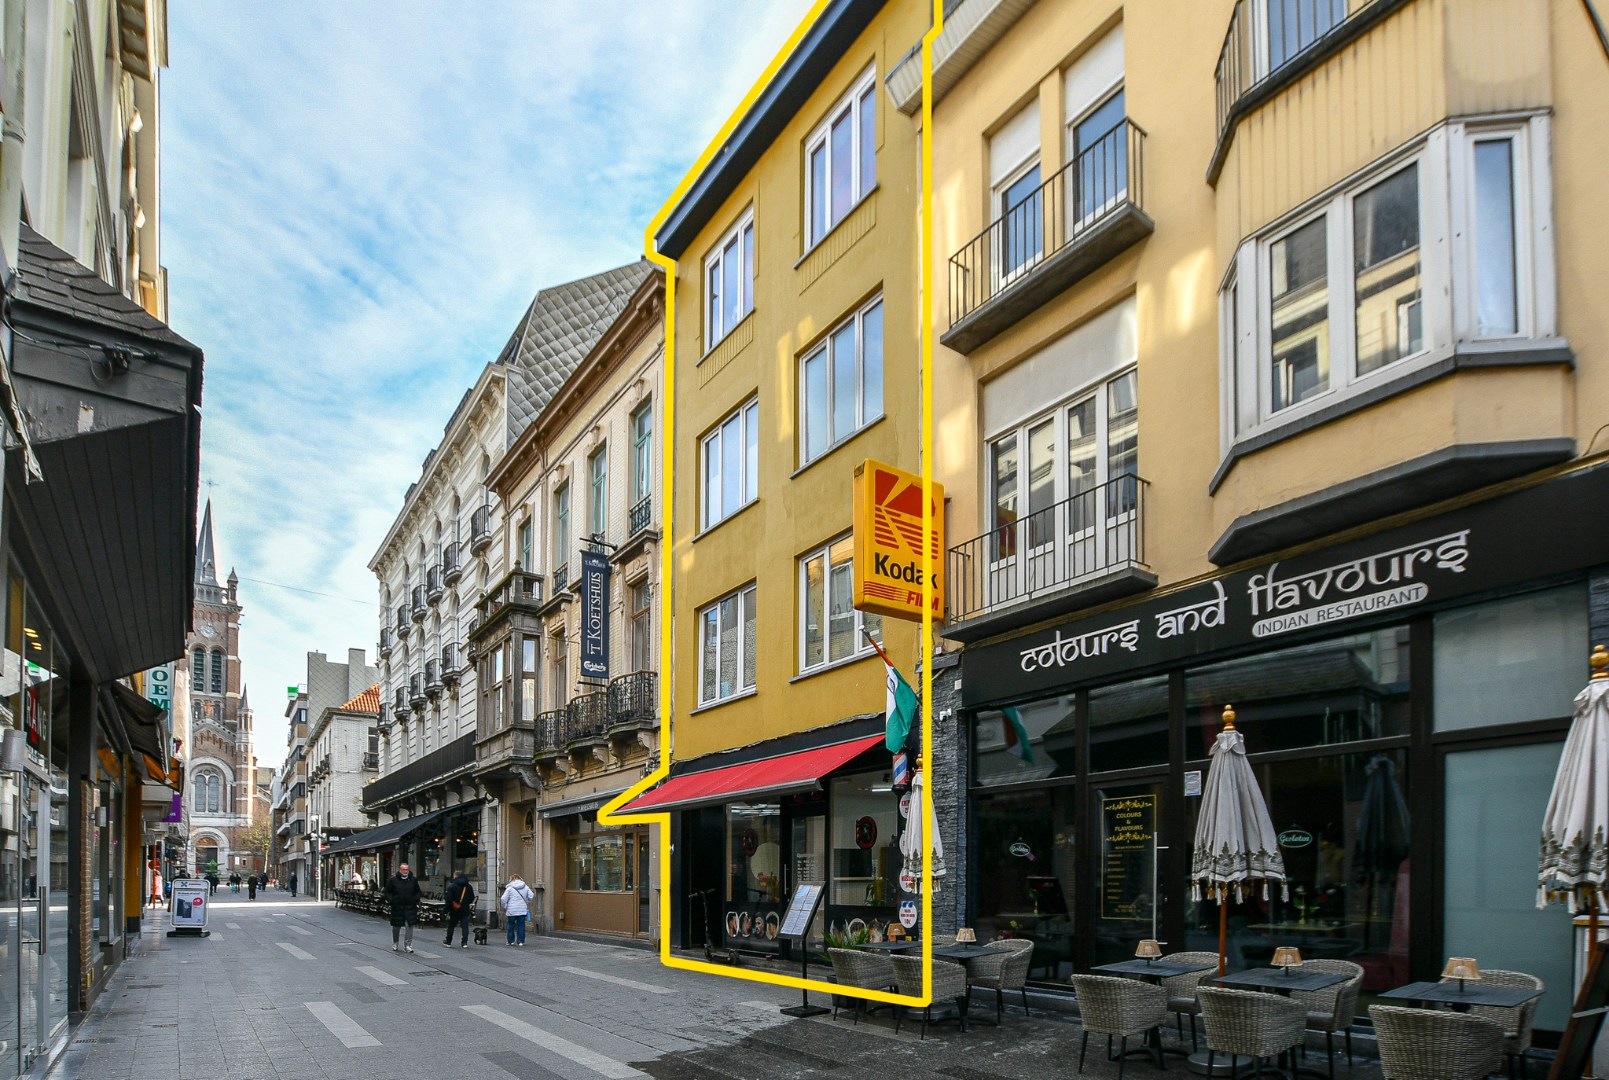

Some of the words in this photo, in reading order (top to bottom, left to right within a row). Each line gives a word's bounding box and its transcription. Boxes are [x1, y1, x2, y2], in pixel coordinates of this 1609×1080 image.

[587, 572, 601, 640] KOETSHUIS
[1019, 619, 1140, 673] colours
[1154, 580, 1229, 639] and
[1247, 529, 1471, 616] flavours
[1257, 613, 1309, 636] INDIAN
[1316, 585, 1424, 622] RESTAURANT
[1115, 811, 1142, 819] COLOURS
